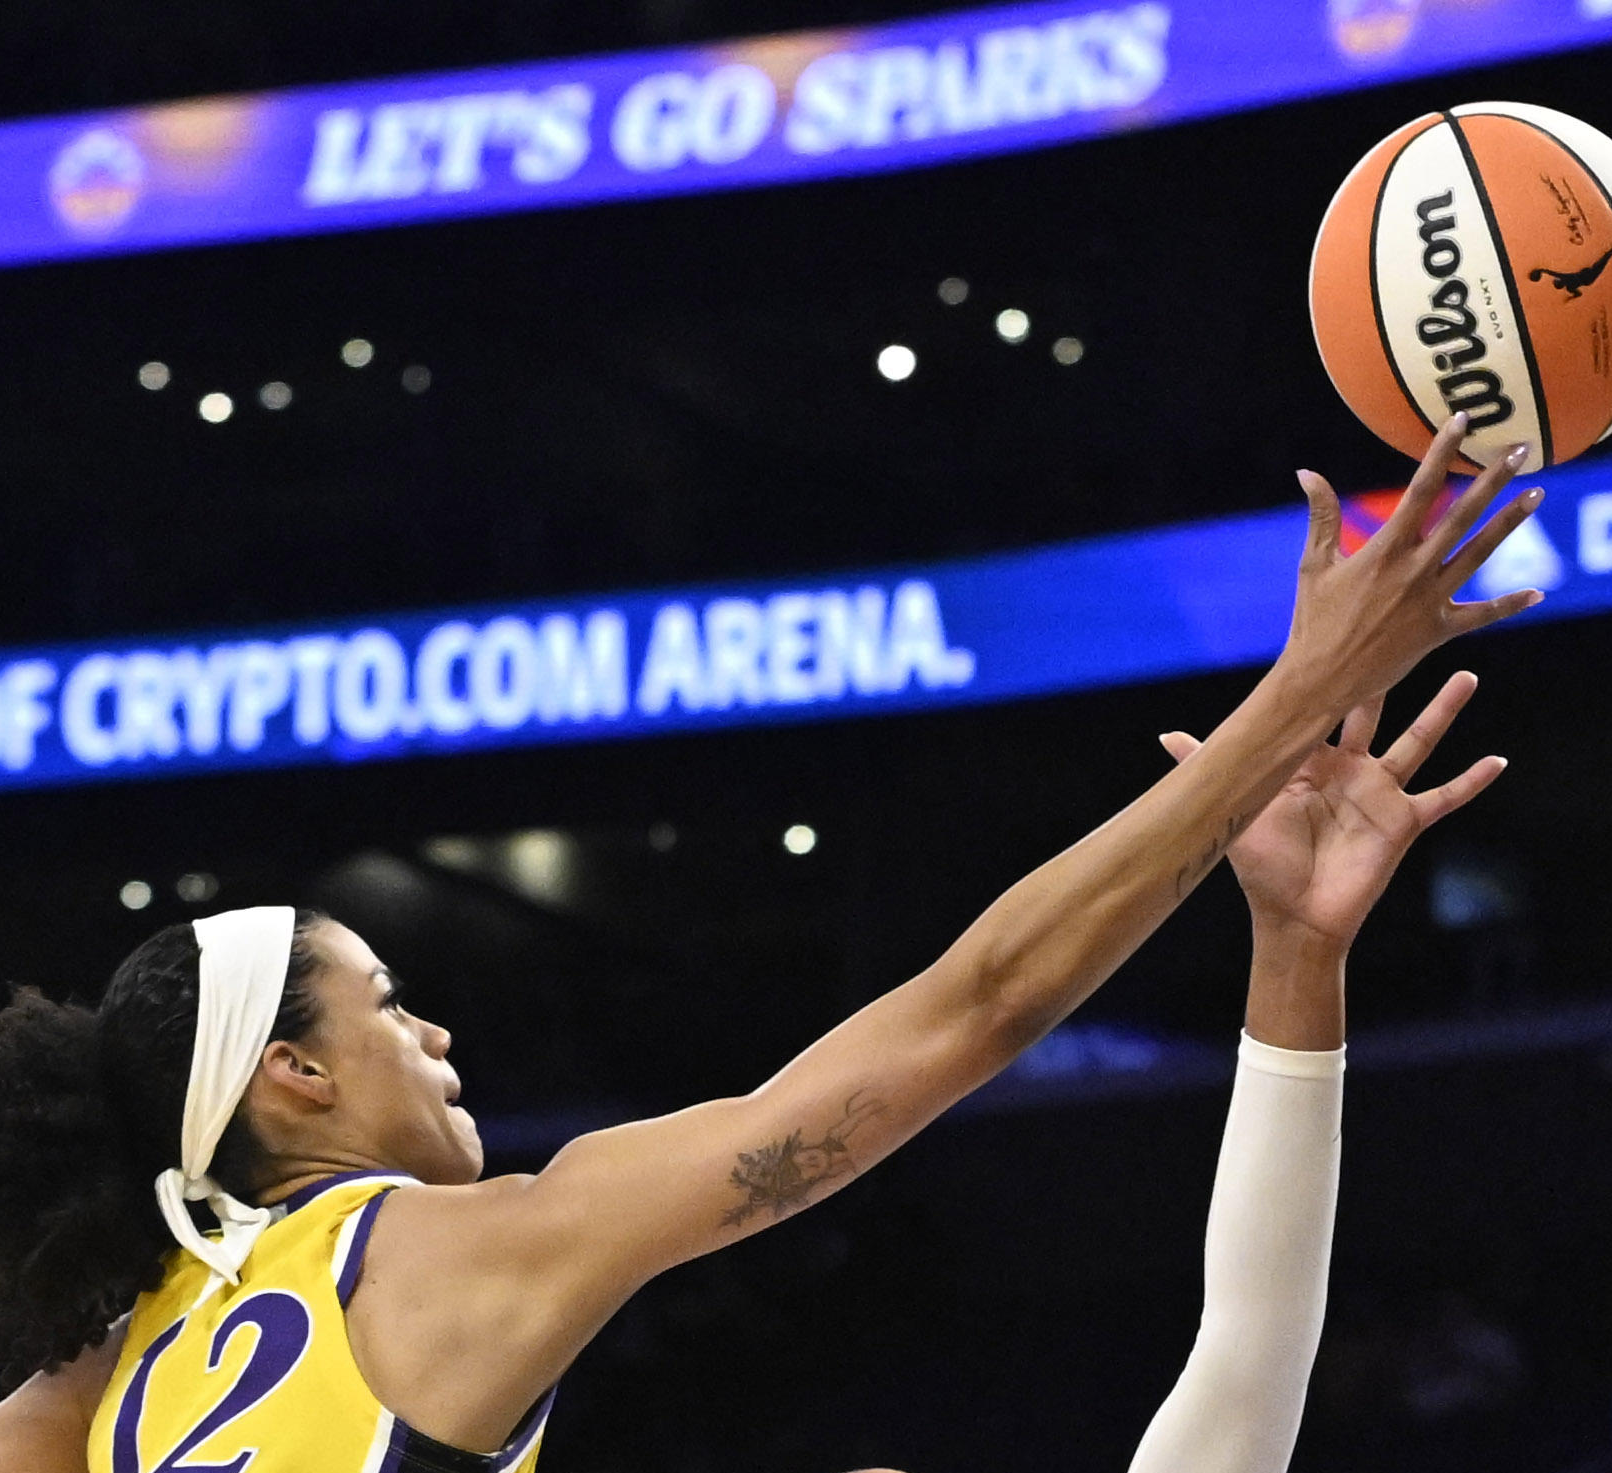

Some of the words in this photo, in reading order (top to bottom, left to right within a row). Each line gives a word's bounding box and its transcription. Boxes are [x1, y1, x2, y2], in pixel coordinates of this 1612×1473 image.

[304, 84, 593, 204] LET'S
[611, 58, 777, 171] GO
[789, 3, 1170, 150] SPARKS
[1415, 186, 1516, 436] Wilson
[61, 613, 628, 766] CRYPTO.COM
[637, 580, 974, 713] ARENA.
